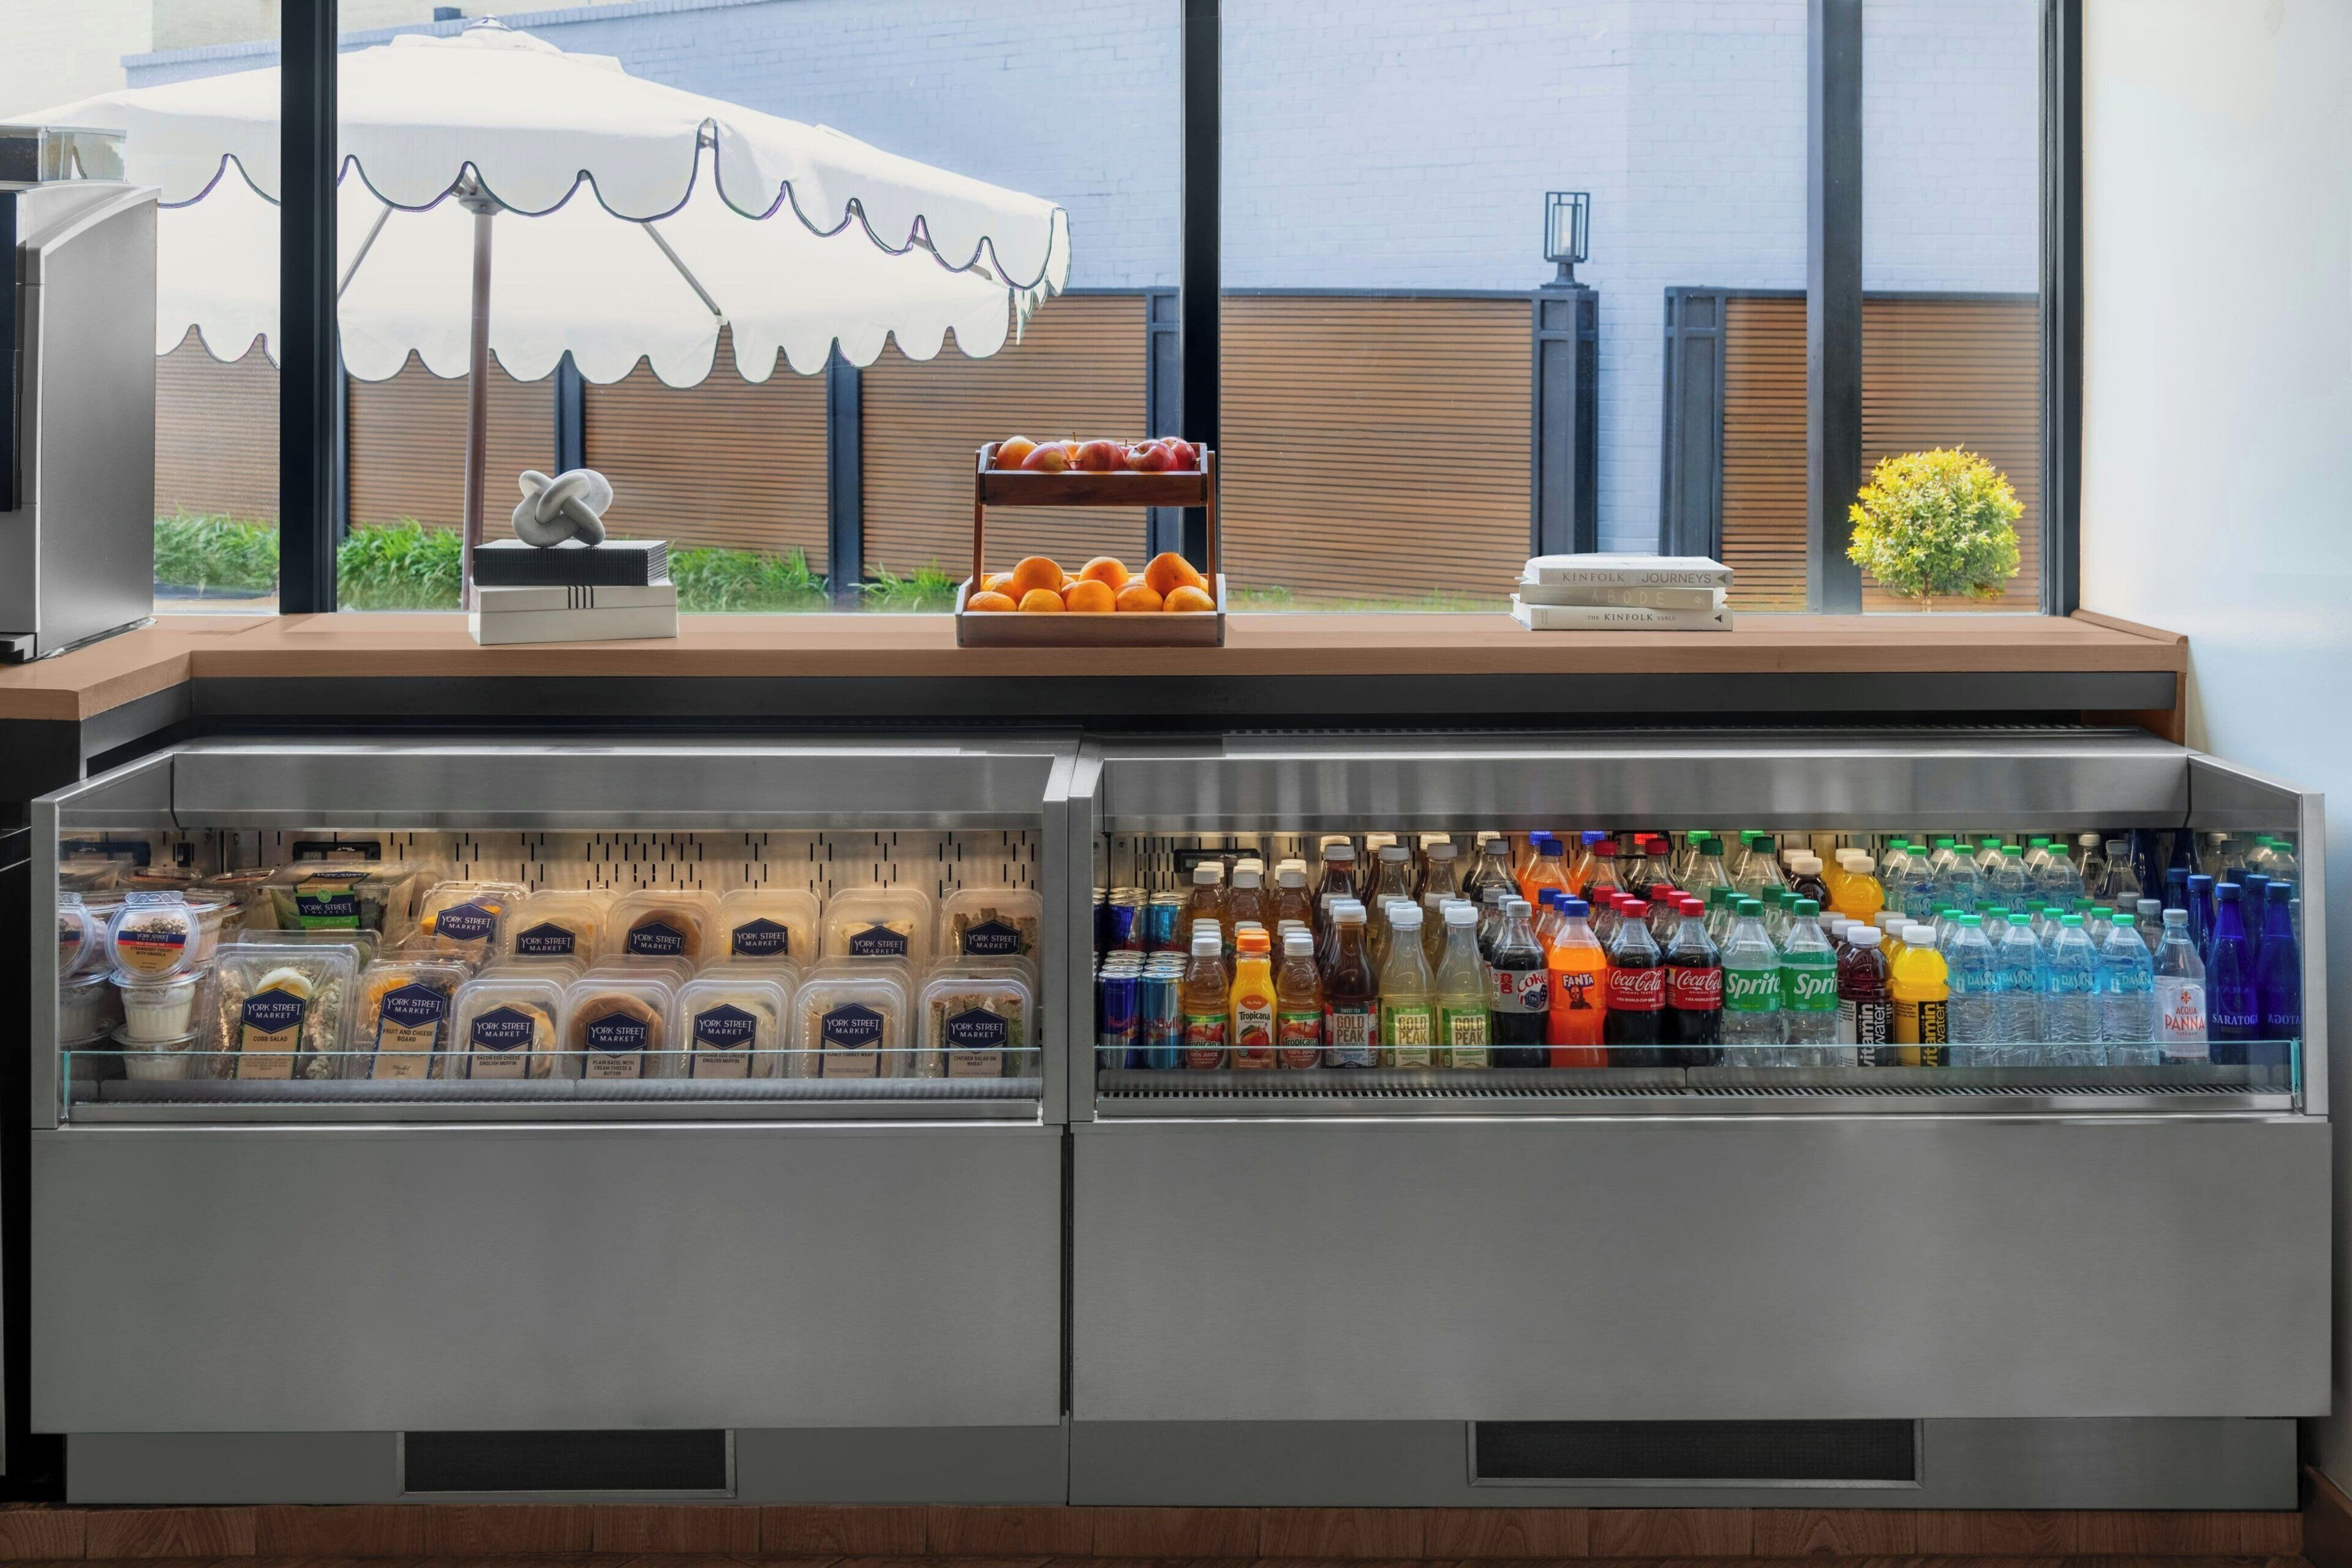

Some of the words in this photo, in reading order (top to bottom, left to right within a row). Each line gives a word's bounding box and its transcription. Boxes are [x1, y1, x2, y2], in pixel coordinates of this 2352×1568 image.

[1562, 572, 1626, 582] KINFOLK
[1642, 572, 1711, 584] JOURNEYS
[1591, 590, 1665, 606] ABODE
[301, 904, 323, 913] YORK
[325, 903, 352, 913] STREET
[442, 916, 462, 926] YORK
[464, 917, 491, 929] STREET
[521, 938, 542, 948] YORK
[544, 937, 571, 948] STREET
[633, 933, 653, 944] YORK
[655, 935, 681, 949] STREET
[737, 933, 758, 944] YORK
[760, 932, 786, 943] STREET
[968, 934, 989, 945] YORK
[991, 935, 1017, 946] STREET
[854, 940, 875, 951] YORK
[877, 940, 903, 951] STREET
[1517, 973, 1547, 993] Coke
[1562, 974, 1594, 987] FANTA
[1610, 970, 1661, 992] Coca-Cola
[1676, 970, 1722, 992] Coca-Cola
[2002, 971, 2035, 986] DASANI
[2061, 974, 2093, 986] DASANI
[2122, 974, 2152, 986] DASANI
[1725, 972, 1781, 999] Sprite
[1793, 971, 1838, 1000] Sprit
[247, 1003, 270, 1016] YORK
[273, 1003, 301, 1016] STREET
[386, 998, 409, 1009] YORK
[412, 999, 442, 1012] STREET
[2176, 1006, 2197, 1015] ACQUA
[1238, 1011, 1270, 1021] Tropicana
[1336, 1016, 1365, 1029] GOLD
[2165, 1014, 2205, 1030] PANNA
[477, 1022, 499, 1034] YORK
[502, 1022, 530, 1034] STREET
[699, 1019, 721, 1031] YORK
[724, 1020, 753, 1032] STREET
[827, 1019, 849, 1031] YORK
[851, 1019, 880, 1031] STREET
[951, 1023, 973, 1035] YORK
[976, 1023, 1004, 1035] STREET
[1398, 1016, 1427, 1030] GOLD
[1455, 1017, 1483, 1031] GOLD
[1874, 1004, 1885, 1049] water
[1936, 1004, 1946, 1049] water
[590, 1027, 614, 1039] YORK
[616, 1027, 645, 1039] STREET
[1336, 1029, 1365, 1042] PEAK
[1398, 1031, 1427, 1044] PEAK
[1455, 1032, 1483, 1045] PEAK
[1858, 1004, 1875, 1066] vitamin
[1921, 1004, 1938, 1066] vitamin
[1284, 1037, 1317, 1047] Tropicana
